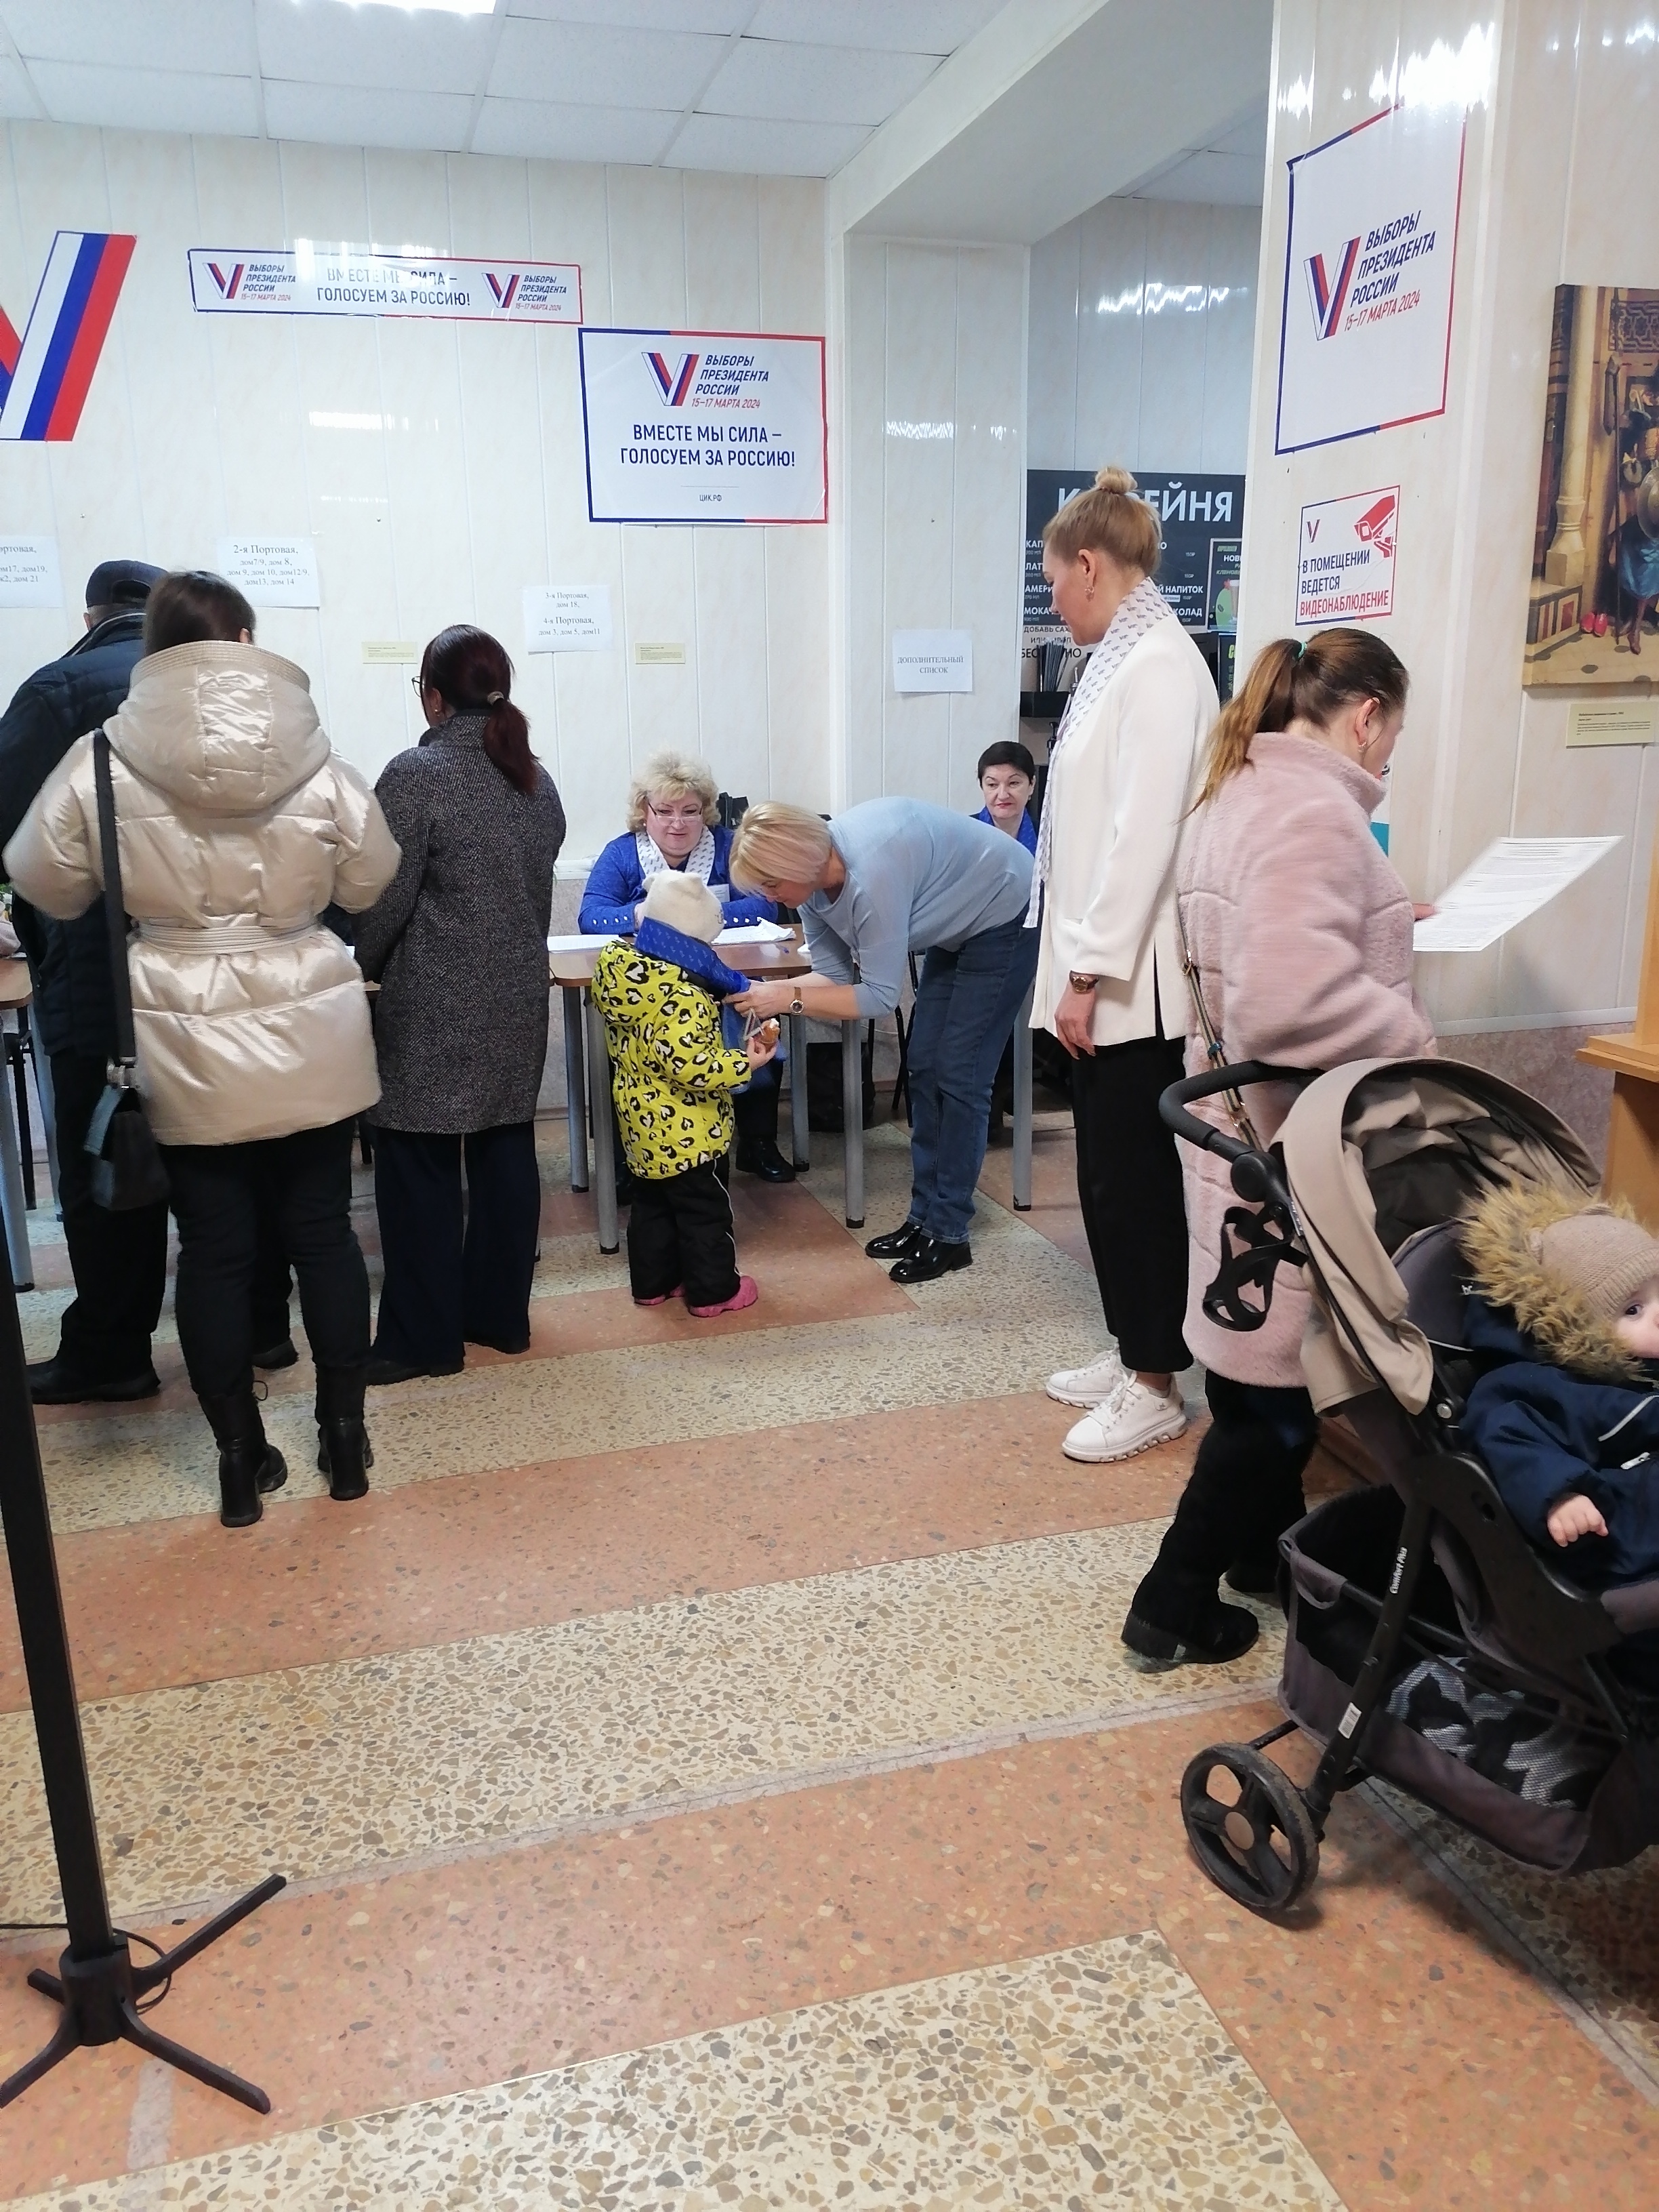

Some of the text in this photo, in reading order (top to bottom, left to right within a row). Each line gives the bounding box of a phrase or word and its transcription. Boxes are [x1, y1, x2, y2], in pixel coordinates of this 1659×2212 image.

[1365, 210, 1422, 252] ВЫБОРЫ
[1357, 230, 1436, 280] ПРЕЗИДЕНТА
[249, 264, 285, 272] ВЫБОРЫ
[246, 274, 296, 283] ПРЕЗИДЕНТА
[524, 274, 556, 283] ВЫБОРЫ
[520, 285, 567, 293] ПРЕЗИДЕНТА
[1350, 272, 1400, 308] РОССИИ
[317, 287, 470, 306] ГОЛОСУЕМ ЗА РОССИЮ!
[517, 293, 548, 302] РОССИИ
[1367, 298, 1397, 323] МАРТА
[1397, 289, 1420, 312] 2024
[705, 354, 755, 367] ВЫБОРЫ
[699, 369, 769, 382] ПРЕЗИДЕНТА
[695, 384, 740, 395] РОССИИ
[714, 399, 741, 408] МАРТА
[741, 399, 760, 409] 2024
[633, 424, 693, 441] ВМЕСТЕ
[697, 426, 724, 442] МЫ
[729, 426, 769, 443] СИЛА
[621, 448, 796, 466] ГОЛОСУЕМ ЗА РОССИЮ!
[699, 494, 722, 502] ЦИК.РФ
[1058, 481, 1233, 522] КЕЙНЯ
[0, 546, 37, 554] ортовая,
[233, 545, 298, 556] 2-я Портовая,
[284, 558, 292, 567] 8,
[1303, 549, 1370, 574] В ПОМЕЩЕНИИ
[1166, 586, 1204, 594] НАПИТОК
[1301, 575, 1340, 596] ВЕДЕТСЯ
[1300, 590, 1389, 618] ВИДЕОНАБЛЮДЕНИЕ
[1173, 608, 1203, 617] КОЛАД
[556, 617, 594, 626] Портовая,
[897, 655, 964, 663] ДОПОЛНИТЕЛЬНЫЙ
